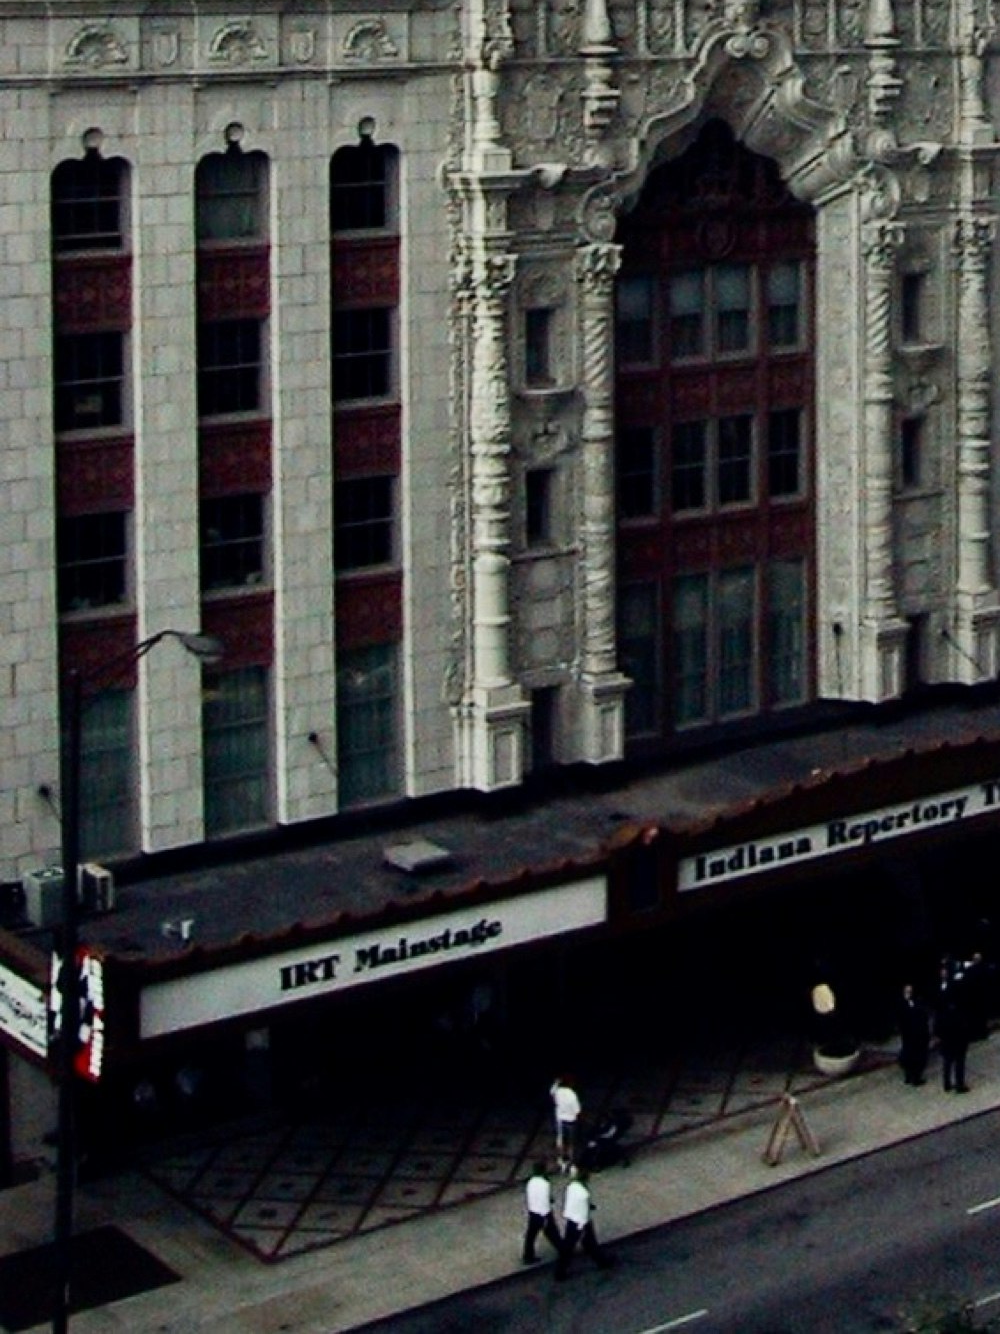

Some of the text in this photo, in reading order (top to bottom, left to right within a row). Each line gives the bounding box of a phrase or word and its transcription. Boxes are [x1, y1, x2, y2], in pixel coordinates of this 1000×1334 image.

[695, 837, 812, 881] Indiana
[826, 795, 969, 847] Repertory
[280, 919, 502, 991] IRT Mainstage
